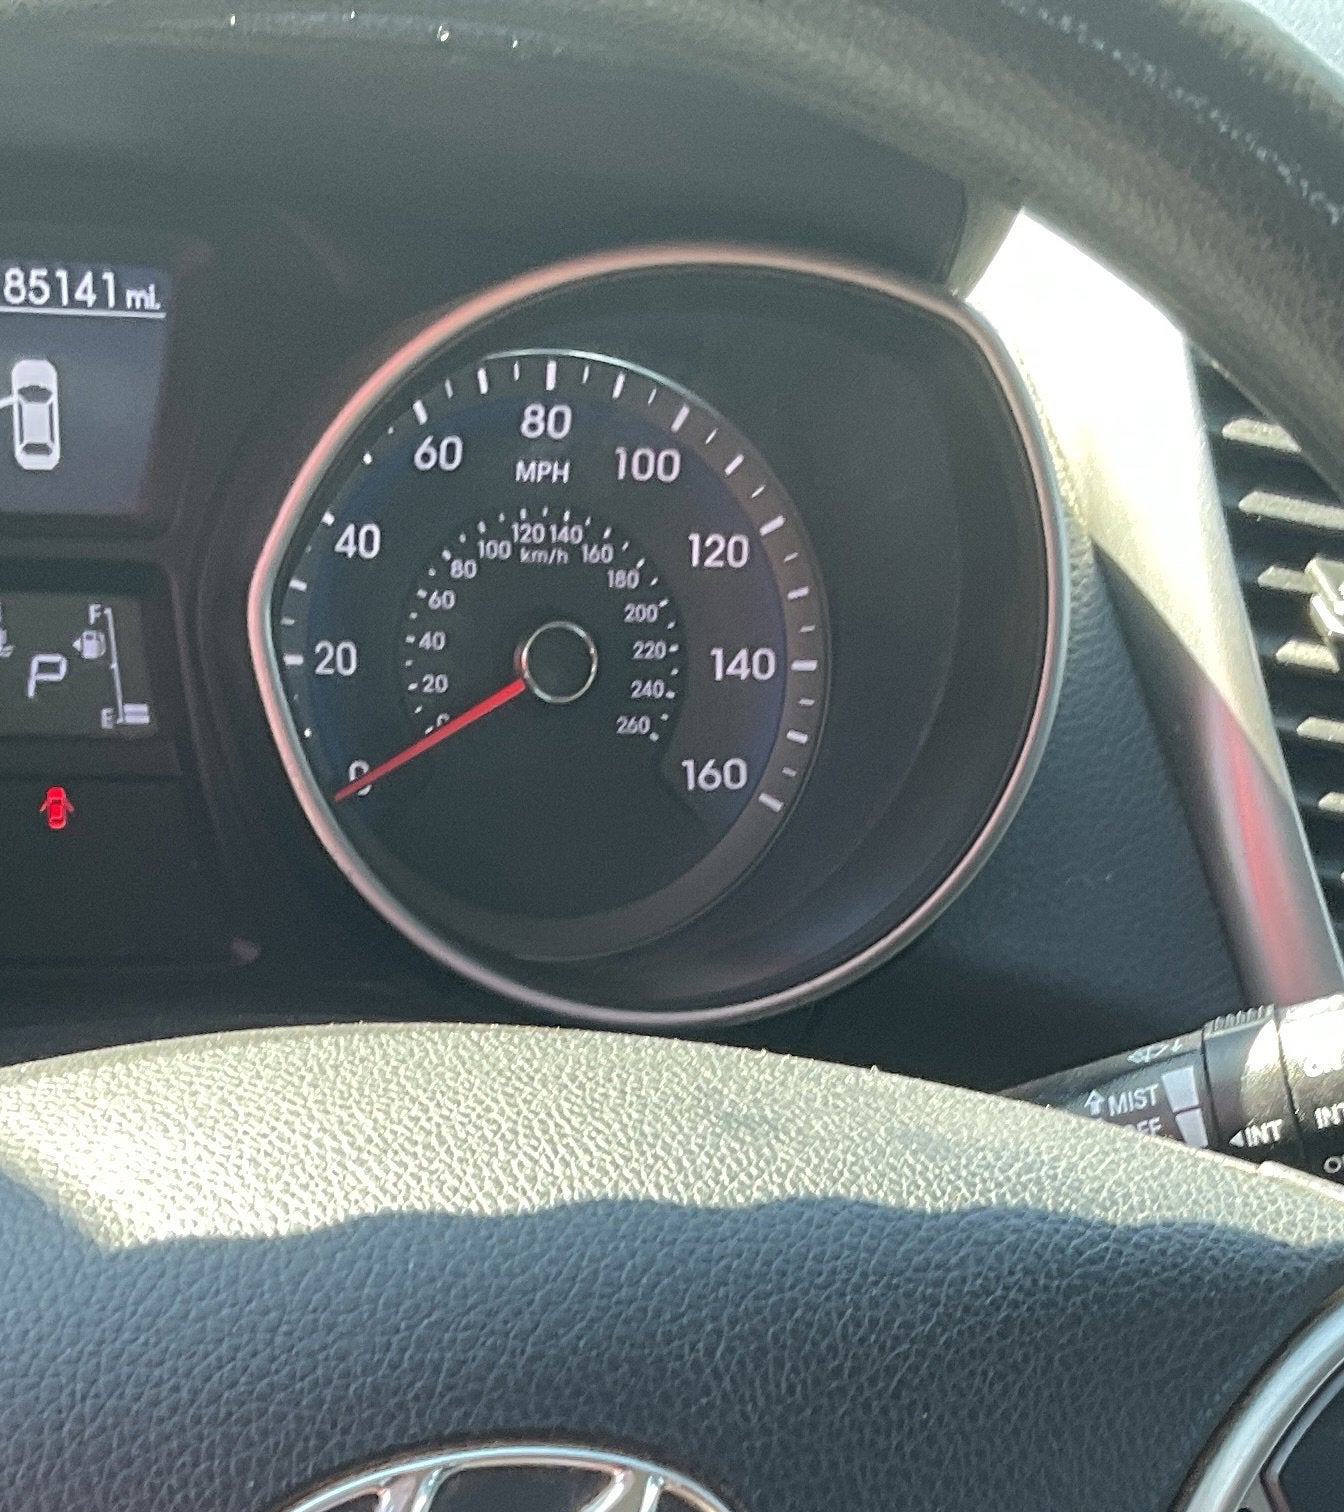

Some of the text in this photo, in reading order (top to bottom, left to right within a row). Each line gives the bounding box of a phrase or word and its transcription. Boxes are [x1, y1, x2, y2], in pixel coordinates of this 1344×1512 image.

[4, 266, 115, 308] 85141
[520, 403, 571, 439] 80
[413, 435, 463, 471] 60
[515, 461, 570, 484] MPH
[614, 447, 681, 483] 100
[334, 523, 381, 559] 40
[512, 522, 545, 544] 120
[550, 523, 584, 545] 140
[478, 539, 512, 560] 100
[519, 546, 569, 565] km/h
[582, 544, 614, 564] 160
[688, 533, 749, 569] 120
[449, 558, 478, 579] 80
[607, 569, 640, 589] 180
[427, 589, 456, 610] 60
[88, 603, 102, 625] F
[624, 603, 658, 624] 200
[419, 631, 447, 651] 40
[632, 640, 667, 661] 220
[313, 641, 358, 677] 20
[709, 648, 777, 683] 140
[27, 652, 68, 699] P
[422, 673, 449, 694] 20
[630, 679, 665, 699] 240
[101, 707, 114, 730] E
[616, 715, 651, 736] 260
[682, 758, 749, 795] 160
[1108, 1084, 1159, 1117] MIST
[1245, 1118, 1283, 1148] INT
